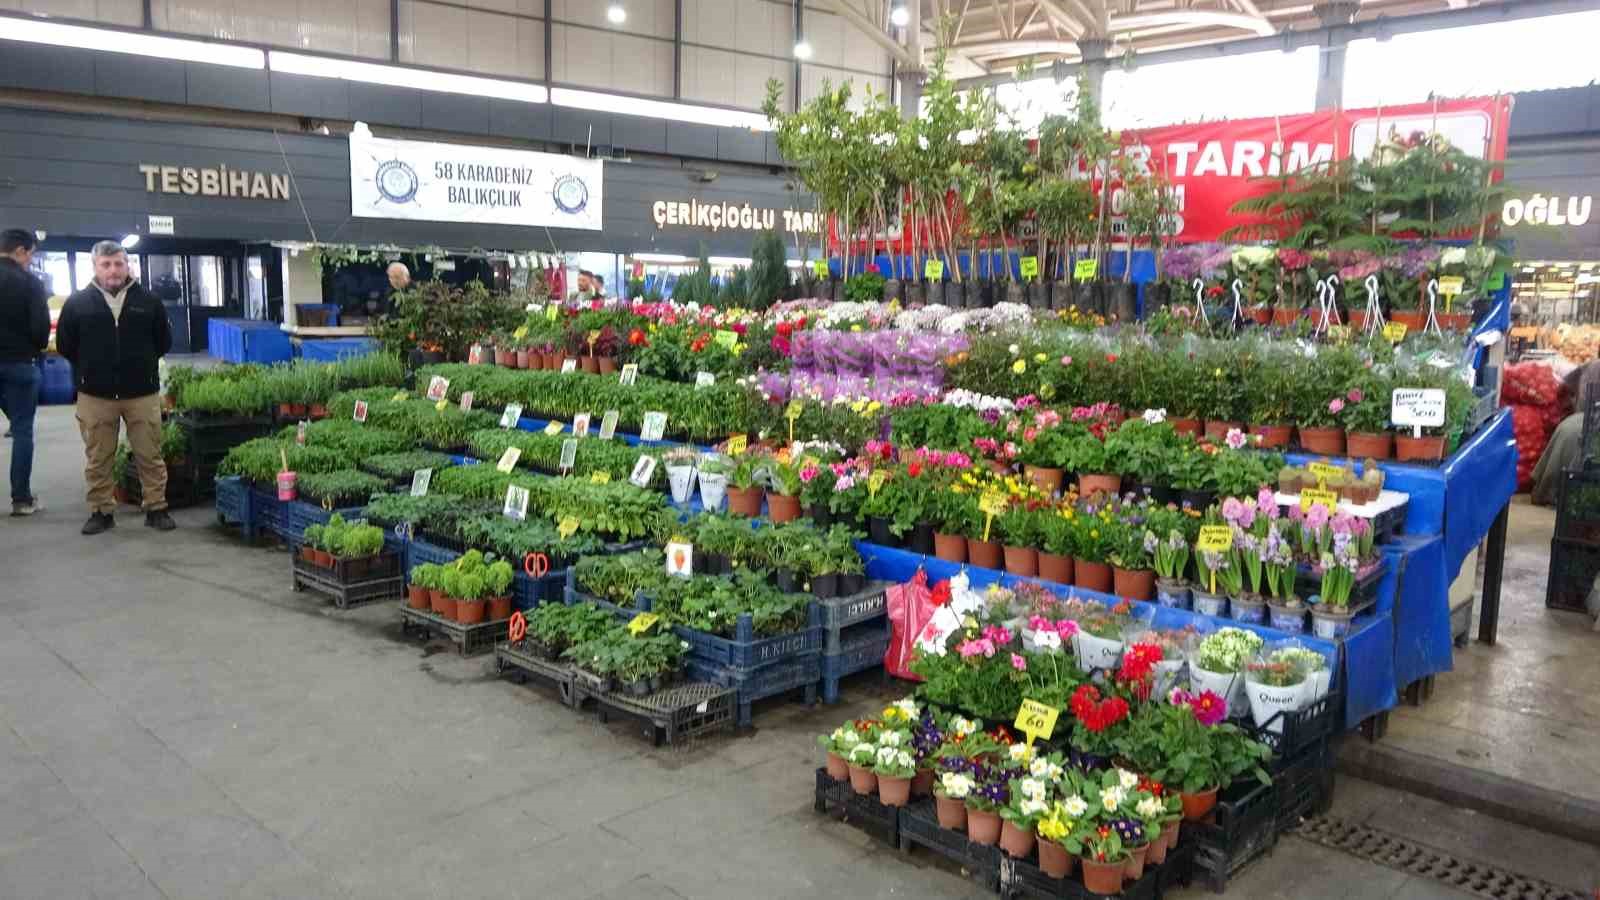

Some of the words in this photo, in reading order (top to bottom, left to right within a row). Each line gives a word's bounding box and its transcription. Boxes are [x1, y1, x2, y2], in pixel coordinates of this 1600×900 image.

[434, 161, 453, 181] 58
[457, 162, 534, 186] KARADENİZ
[1167, 140, 1333, 178] TARIM
[139, 163, 290, 200] TESBİHAN
[448, 185, 522, 209] BALIKÇILIK
[653, 198, 775, 232] ÇERİKÇİOĞLU
[1259, 692, 1293, 703] Queen
